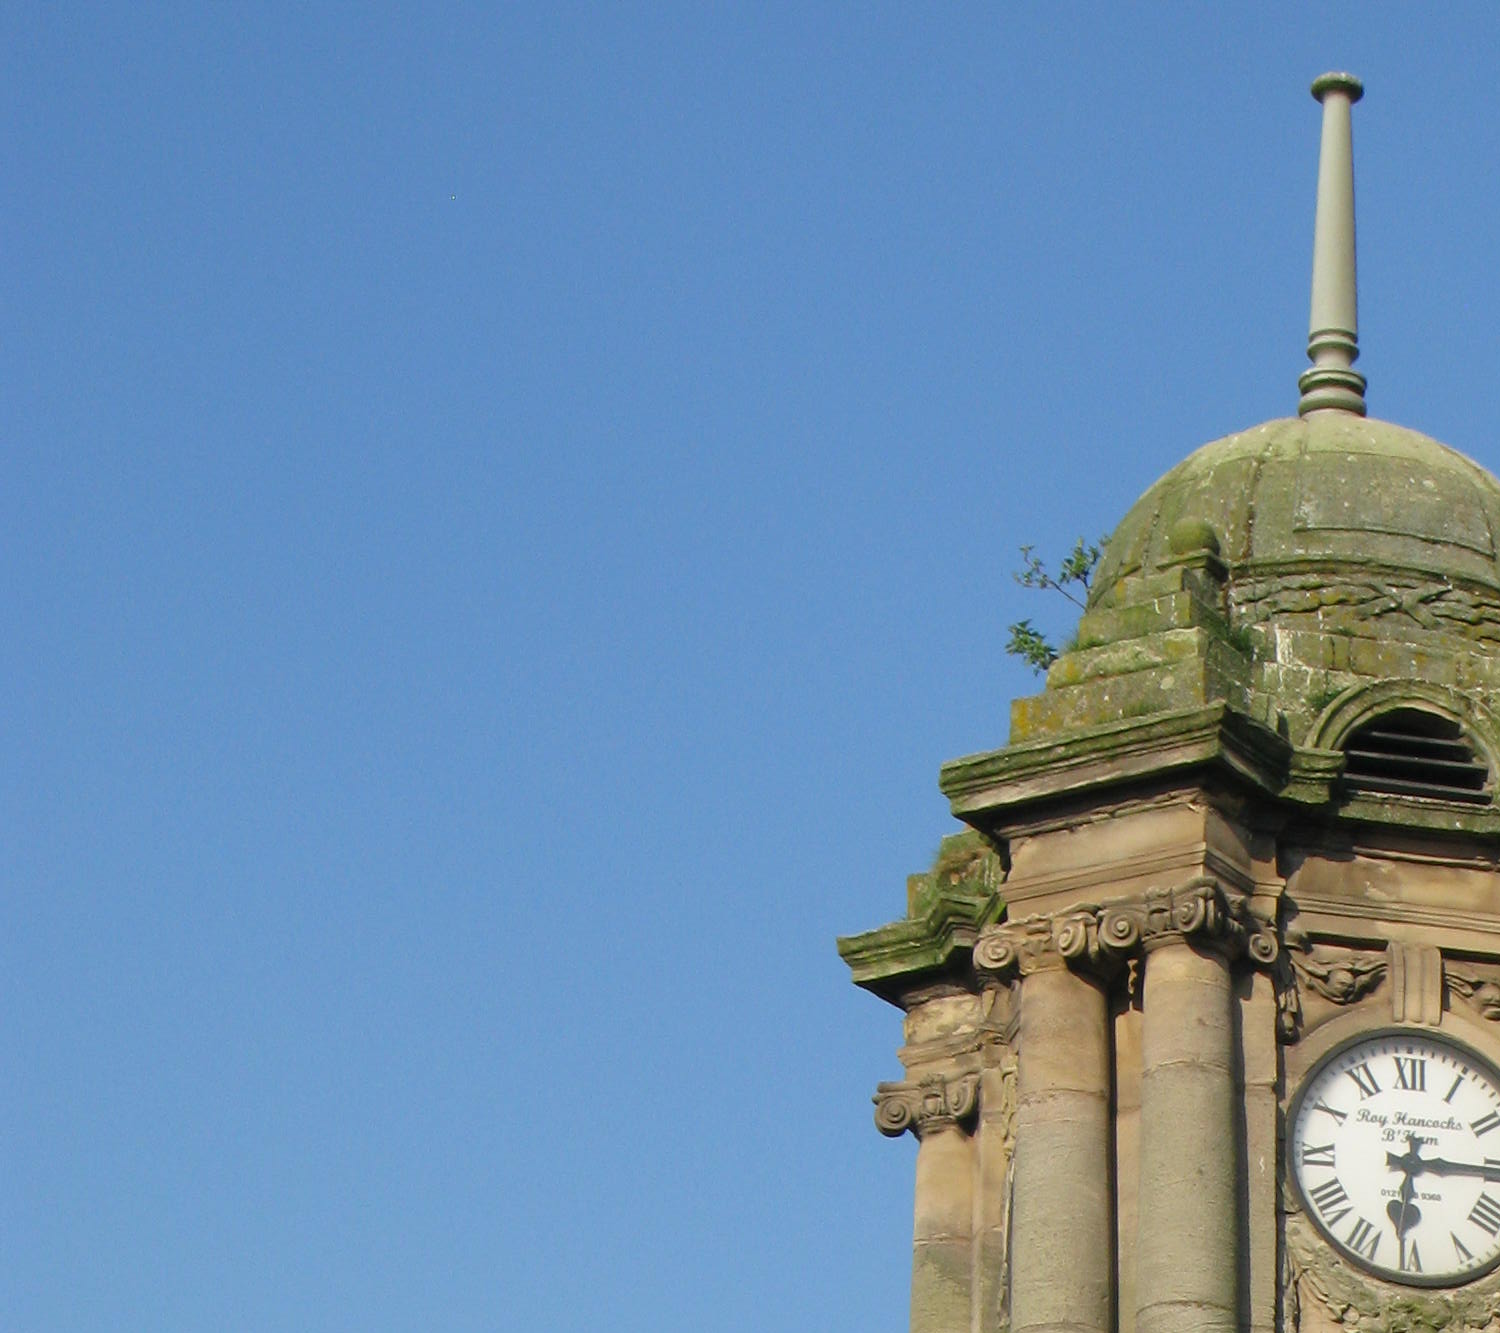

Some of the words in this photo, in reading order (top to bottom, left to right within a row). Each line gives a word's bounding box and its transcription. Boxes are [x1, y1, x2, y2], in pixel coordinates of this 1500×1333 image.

[1344, 1062, 1383, 1101] XI
[1393, 1055, 1427, 1092] XII
[1442, 1073, 1465, 1104] I
[1312, 1095, 1348, 1127] X
[1357, 1108, 1388, 1127] Roy
[1392, 1111, 1463, 1131] Hancocks
[1301, 1142, 1336, 1168] IX
[1308, 1176, 1354, 1229] VIII
[1344, 1216, 1383, 1262] VII
[1449, 1231, 1475, 1264] V
